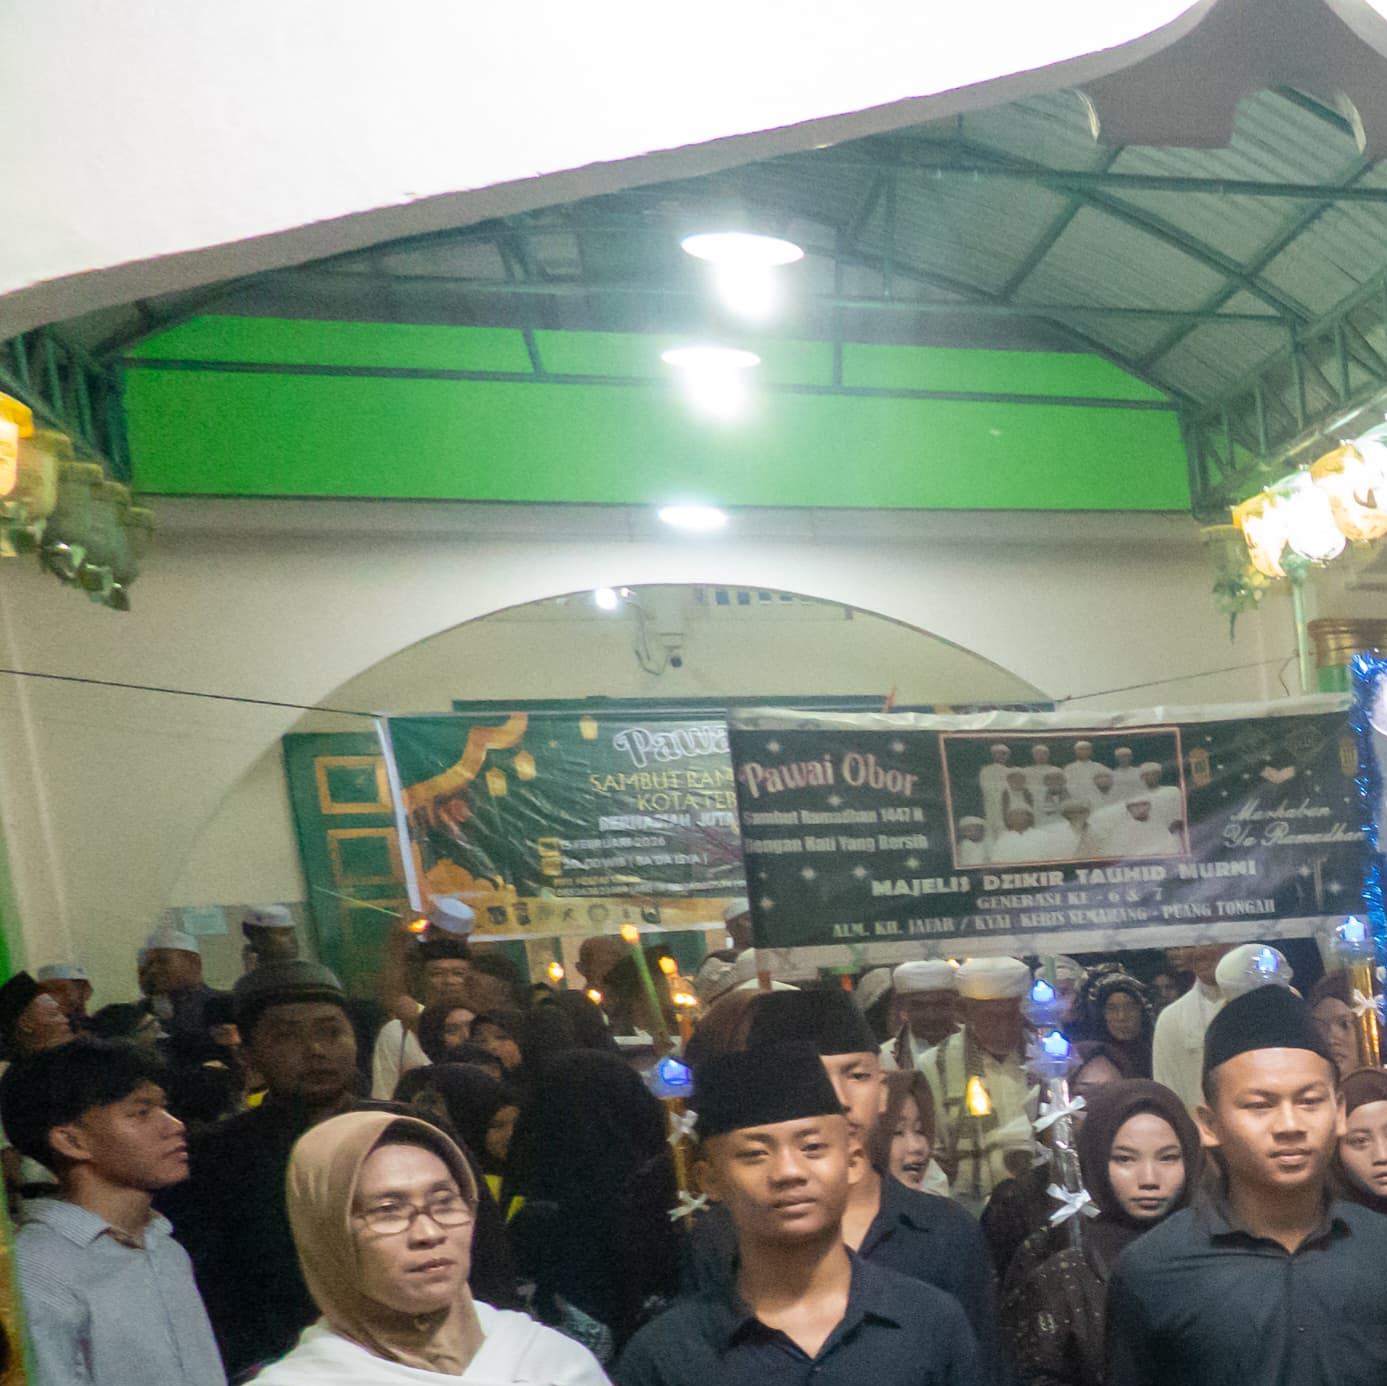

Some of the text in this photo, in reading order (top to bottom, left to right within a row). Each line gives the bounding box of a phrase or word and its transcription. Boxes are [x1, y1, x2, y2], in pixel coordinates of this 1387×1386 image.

[590, 772, 679, 792] SAMBUT
[739, 752, 918, 798] Pawai Obor
[637, 791, 698, 811] KOTA
[871, 860, 1256, 896] MAJELIS DZIKIR TAUHID MURNI
[976, 892, 1061, 910] GENERASI
